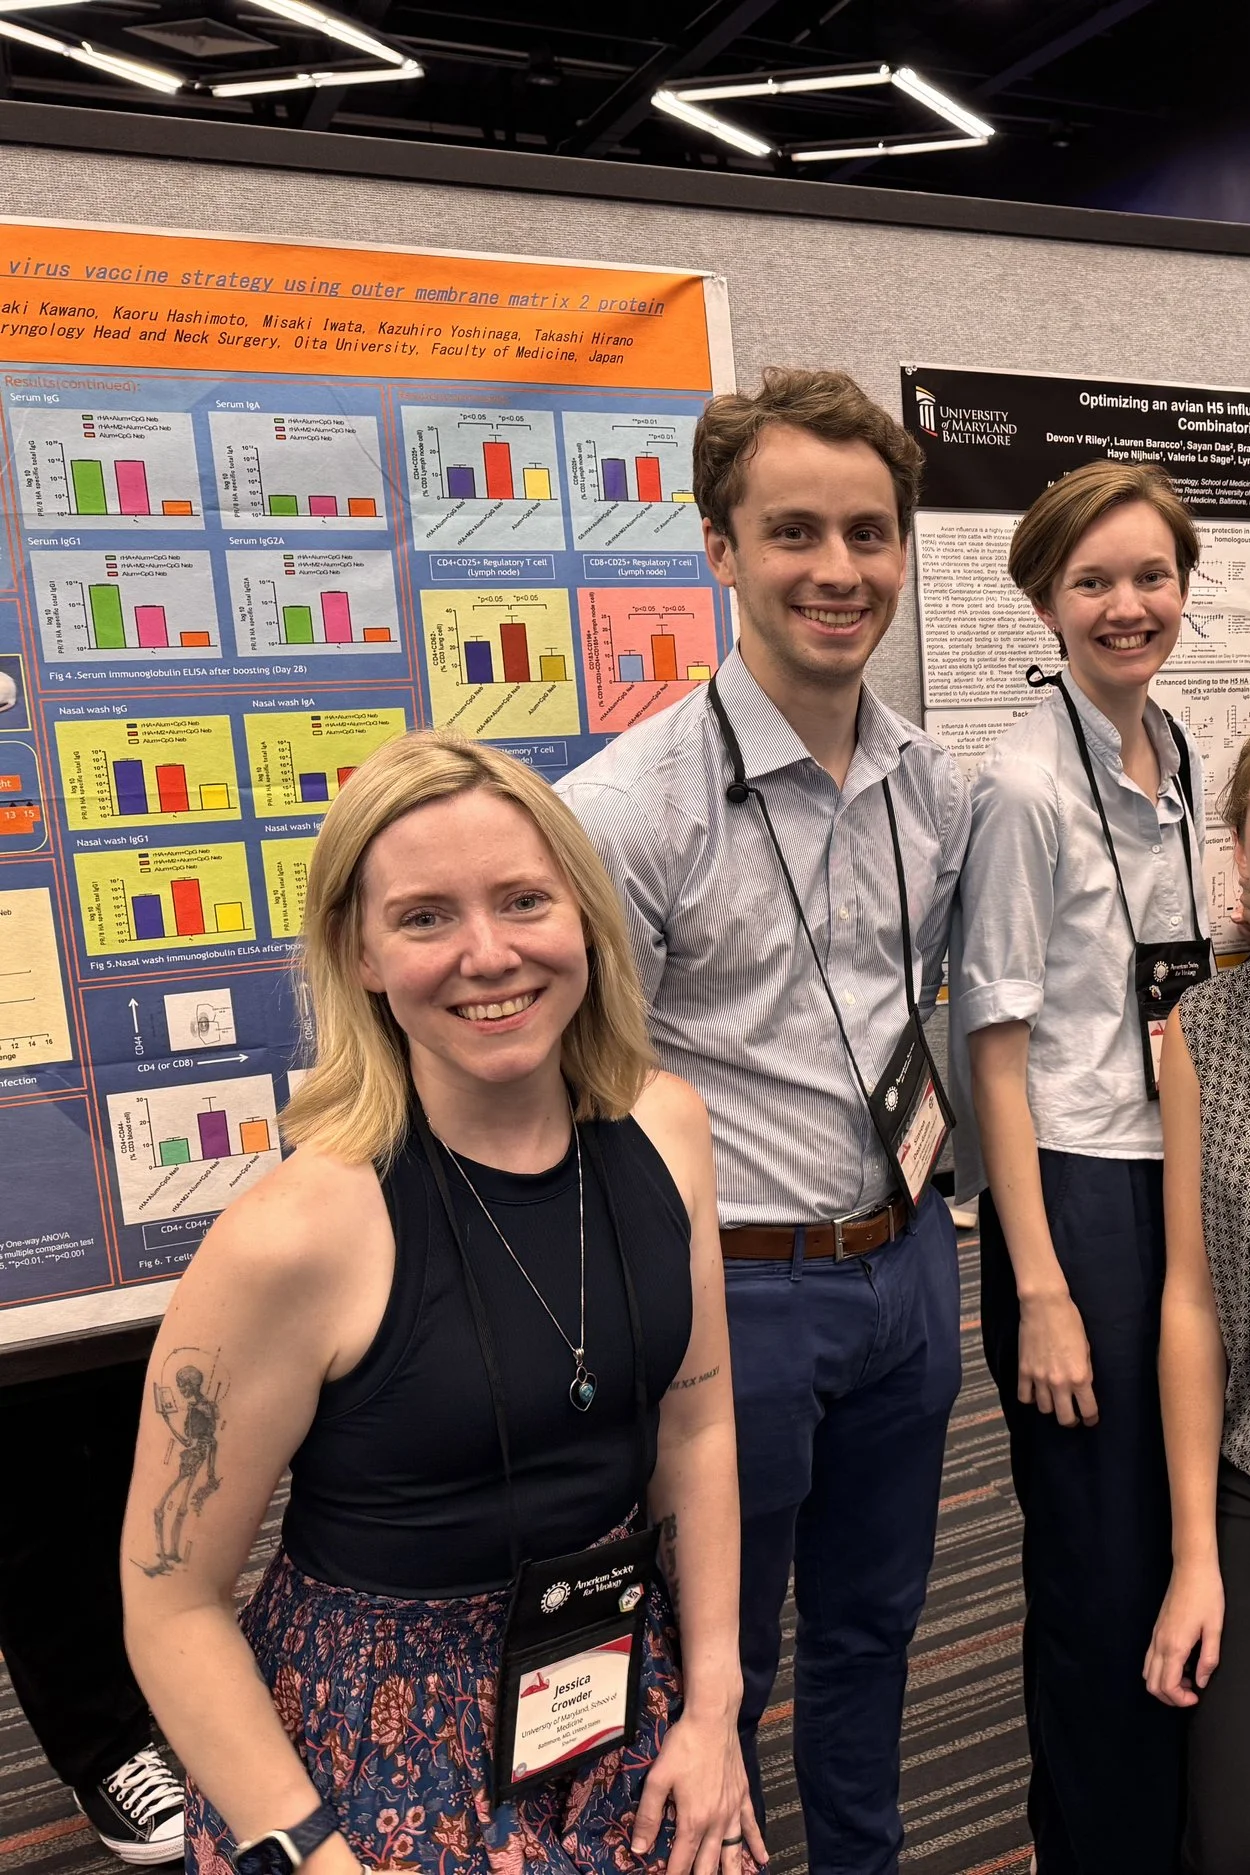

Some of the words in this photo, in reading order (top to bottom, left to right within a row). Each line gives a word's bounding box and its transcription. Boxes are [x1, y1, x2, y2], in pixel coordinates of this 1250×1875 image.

[9, 257, 70, 277] virus
[85, 262, 169, 283] vaccine
[181, 270, 273, 293] strategy
[284, 275, 341, 298] using
[352, 281, 405, 299] outer
[415, 286, 499, 305] membrane
[508, 292, 569, 310] matrix
[579, 294, 590, 310] 2
[598, 297, 665, 316] protein
[39, 302, 98, 318] Kawano,
[112, 306, 158, 321] Kaoru
[166, 309, 247, 326] Hashimoto,
[262, 314, 312, 329] Misaki
[323, 318, 365, 333] Iwata,
[377, 321, 441, 336] Kazuhiro
[451, 325, 520, 341] Yoshinaga,
[535, 328, 584, 342] Takashi
[591, 332, 633, 346] Hirano
[93, 326, 131, 339] Head
[138, 330, 166, 341] and
[173, 330, 209, 343] Neck
[217, 332, 280, 348] Surgery,
[294, 335, 327, 349] Oita
[335, 338, 418, 355] University,
[431, 342, 486, 358] Faculty
[493, 345, 510, 357] of
[515, 346, 577, 361] Medicine,
[588, 350, 623, 364] Japan
[9, 392, 40, 401] Serum
[43, 393, 59, 404] IgG
[1079, 392, 1148, 412] Optimizing
[1152, 400, 1167, 410] an
[1170, 400, 1203, 412] avian
[1207, 401, 1224, 414] H5
[940, 406, 1008, 421] UNIVERSITY
[942, 421, 950, 431] of
[952, 419, 1017, 434] MARYLAND
[943, 431, 1010, 445] BALTIMORE
[1046, 432, 1074, 443] Devon
[1076, 434, 1083, 443] V
[1114, 436, 1143, 447] Lauren
[1186, 440, 1212, 452] Sayan
[27, 537, 58, 545] Serum
[60, 536, 80, 546] IgG1
[229, 536, 257, 544] Serum
[259, 536, 284, 546] IgG2A
[483, 558, 524, 567] Regulatory
[532, 558, 547, 566] cell
[632, 558, 670, 567] Regulatory
[672, 558, 677, 566] T
[467, 568, 495, 577] (Lymph
[497, 568, 520, 577] node)
[618, 568, 644, 577] (Lymph
[645, 568, 666, 577] node)
[49, 671, 64, 681] Fig
[108, 669, 180, 678] immunoglobulin
[182, 667, 207, 676] ELISA
[209, 667, 230, 675] after
[232, 667, 270, 675] boosting
[272, 665, 291, 674] (Day
[293, 664, 307, 673] 28)
[1187, 678, 1210, 686] binding
[59, 706, 85, 714] Nasal
[86, 705, 110, 713] wash
[112, 704, 127, 714] IgG
[532, 746, 538, 754] T
[540, 746, 554, 754] cell
[5, 811, 16, 819] 13
[24, 810, 34, 818] 15
[90, 961, 104, 970] Fig
[141, 955, 164, 964] wash
[166, 949, 235, 961] immunoglobulin
[237, 946, 260, 955] ELISA
[262, 943, 287, 952] after
[137, 1063, 155, 1072] CD4
[157, 1062, 170, 1070] (or
[172, 1058, 193, 1068] CD8)
[6, 1238, 39, 1249] One-way
[41, 1231, 70, 1243] ANOVA
[4, 1249, 34, 1258] multiple
[35, 1241, 78, 1254] comparison
[80, 1238, 94, 1246] test
[138, 1260, 152, 1268] Fig
[165, 1255, 171, 1263] T
[574, 1574, 610, 1591] American
[611, 1565, 634, 1578] Society
[583, 1588, 594, 1597] for
[596, 1580, 623, 1592] Virology
[553, 1674, 591, 1700] Jessica
[551, 1690, 592, 1713] Crowder
[521, 1721, 552, 1738] University
[557, 1718, 583, 1733] Medicine
